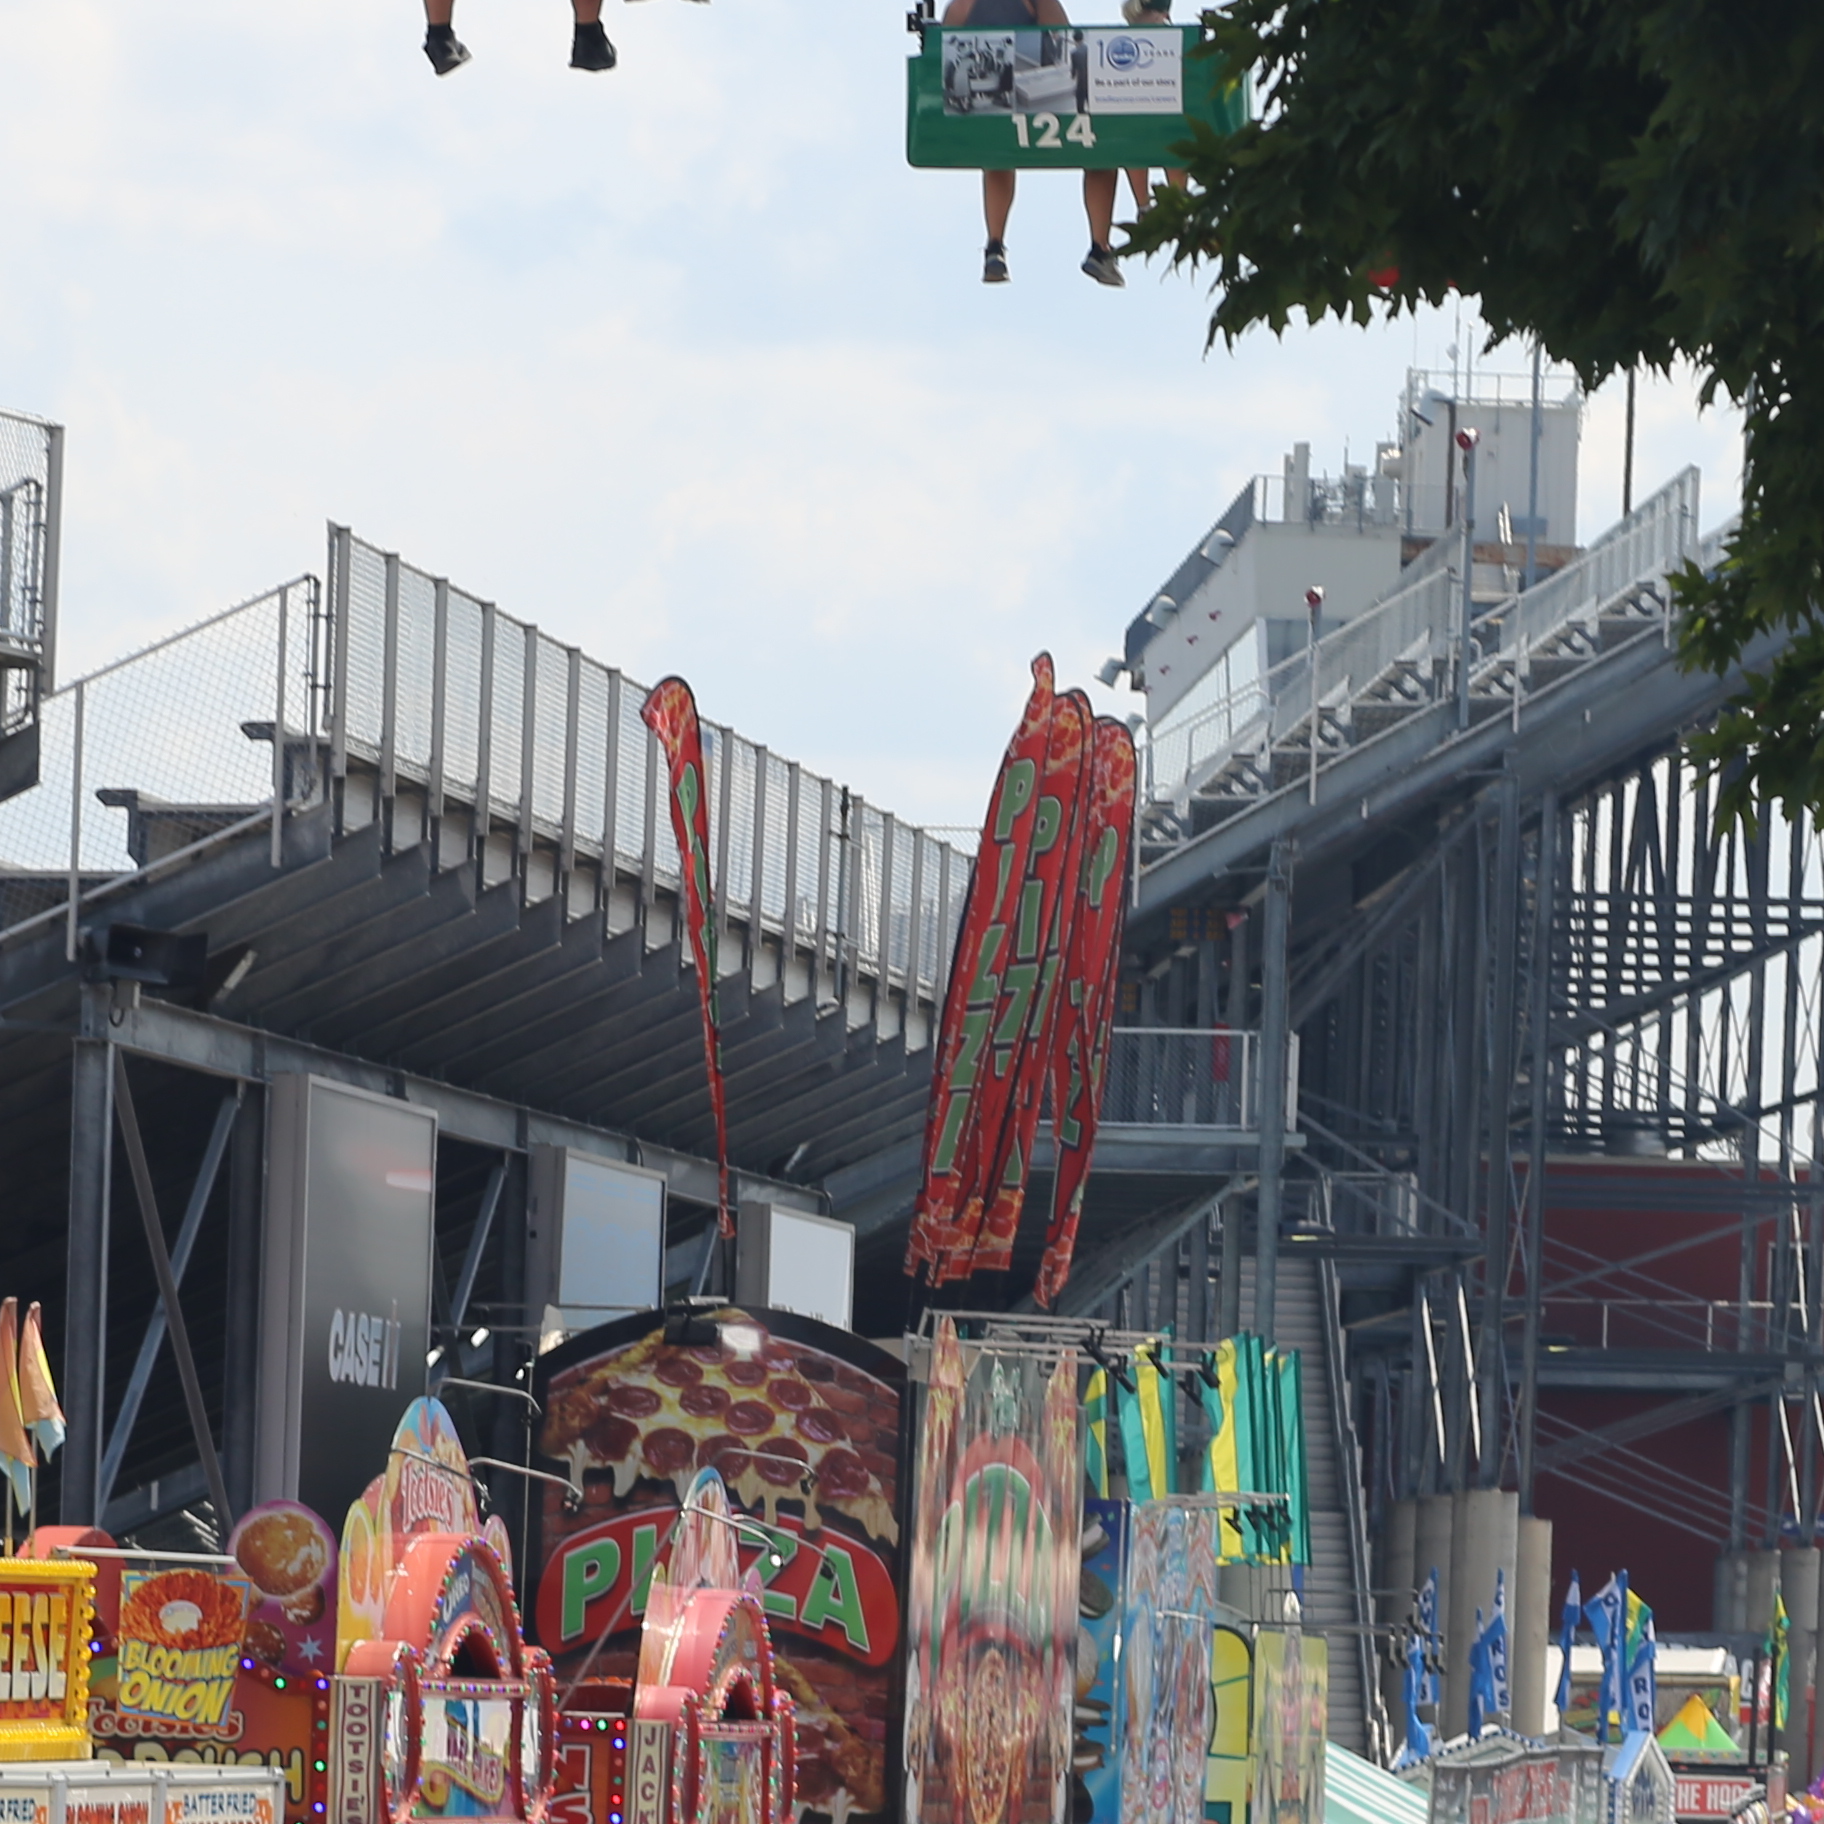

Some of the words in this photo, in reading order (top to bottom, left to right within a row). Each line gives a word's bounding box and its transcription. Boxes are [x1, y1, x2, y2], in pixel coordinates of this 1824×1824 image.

[1011, 111, 1096, 148] 124
[329, 1308, 384, 1388] CASE
[560, 1524, 872, 1653] PIZA
[126, 1637, 239, 1678] BLOOMING
[119, 1671, 233, 1724] ONION
[7, 1798, 37, 1824] FRIED
[183, 1793, 227, 1817] BATTER
[227, 1791, 257, 1816] FRIED
